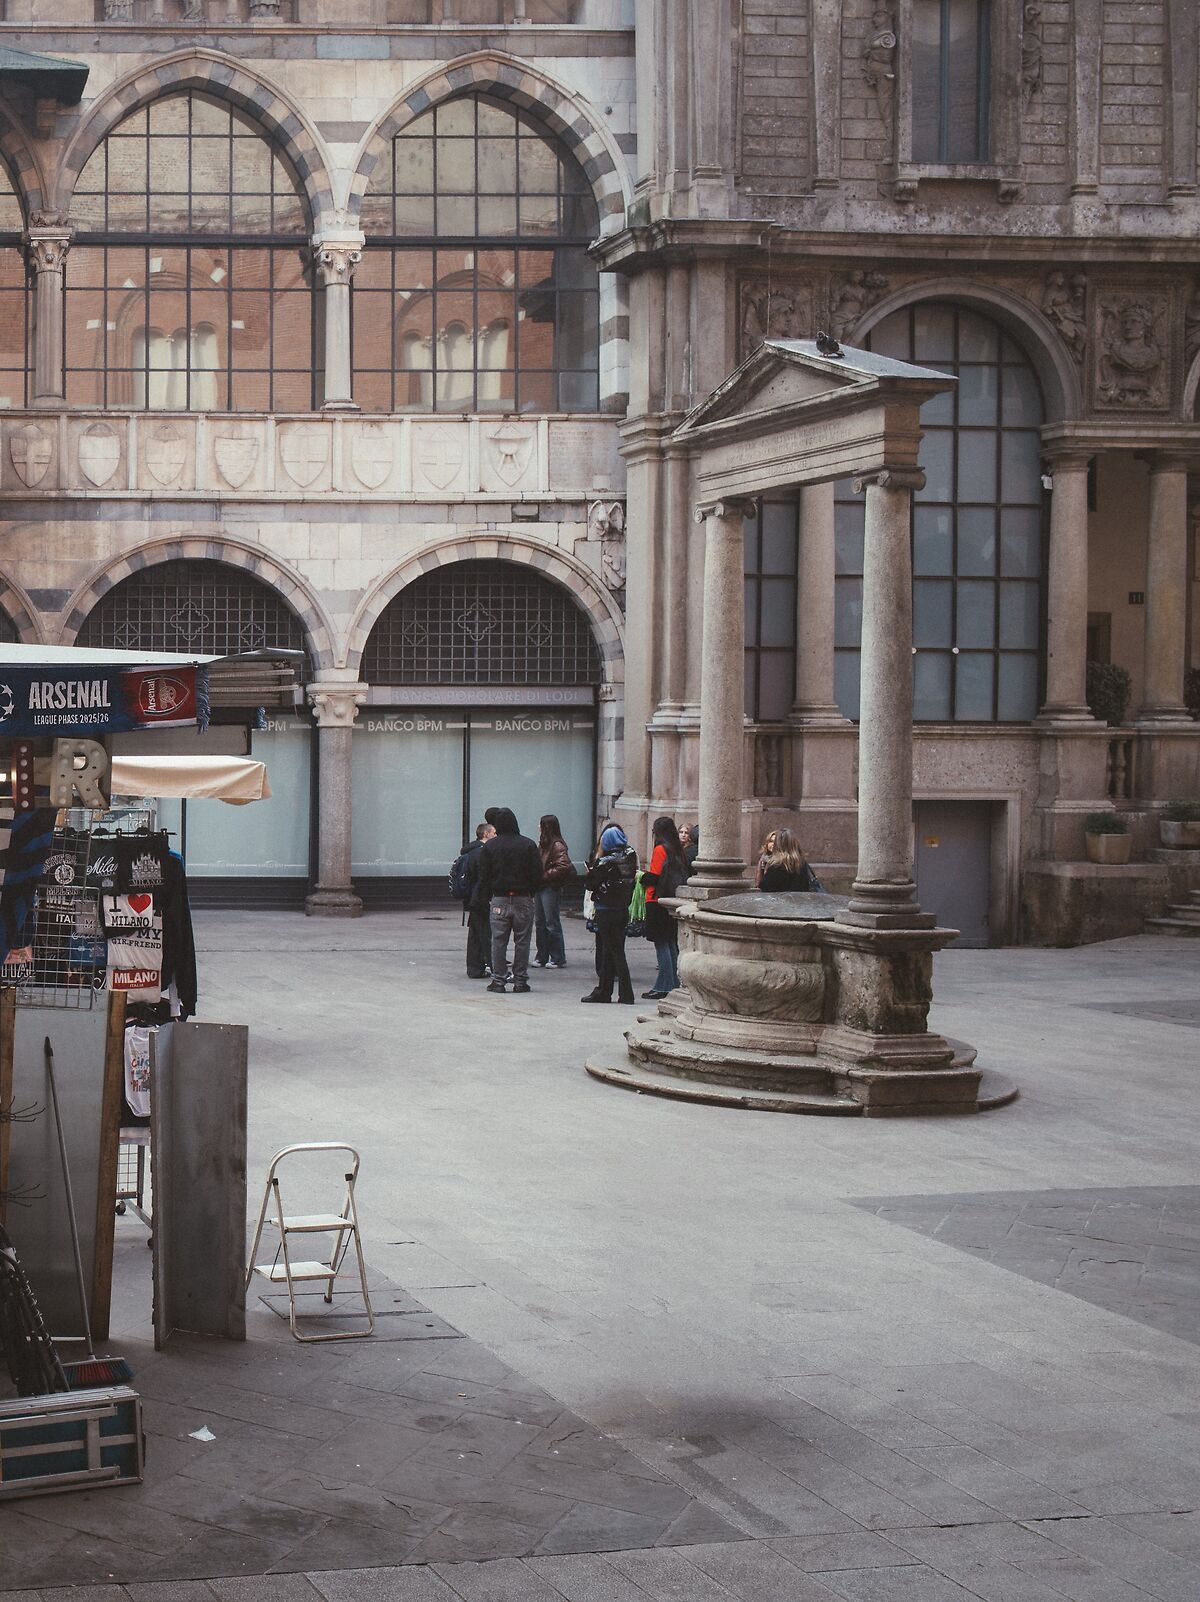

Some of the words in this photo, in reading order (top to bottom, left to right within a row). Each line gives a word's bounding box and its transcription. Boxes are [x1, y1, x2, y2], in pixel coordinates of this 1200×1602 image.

[28, 680, 112, 710] ARSENAL
[147, 680, 156, 711] Arsenal
[391, 690, 442, 703] BANCA
[447, 690, 521, 703] POPOLARE
[527, 690, 540, 703] DI
[545, 690, 578, 703] LODI
[34, 715, 57, 726] LEAGUE
[58, 714, 79, 725] PHASE
[80, 713, 109, 724] 2025/26
[367, 720, 415, 732] BANCO
[416, 720, 443, 732] BPM
[495, 720, 542, 732] BANCO
[546, 720, 570, 732] BPM
[109, 894, 122, 913] I
[111, 915, 150, 928] MILANO
[136, 928, 163, 941] MY
[114, 971, 158, 984] MILANO
